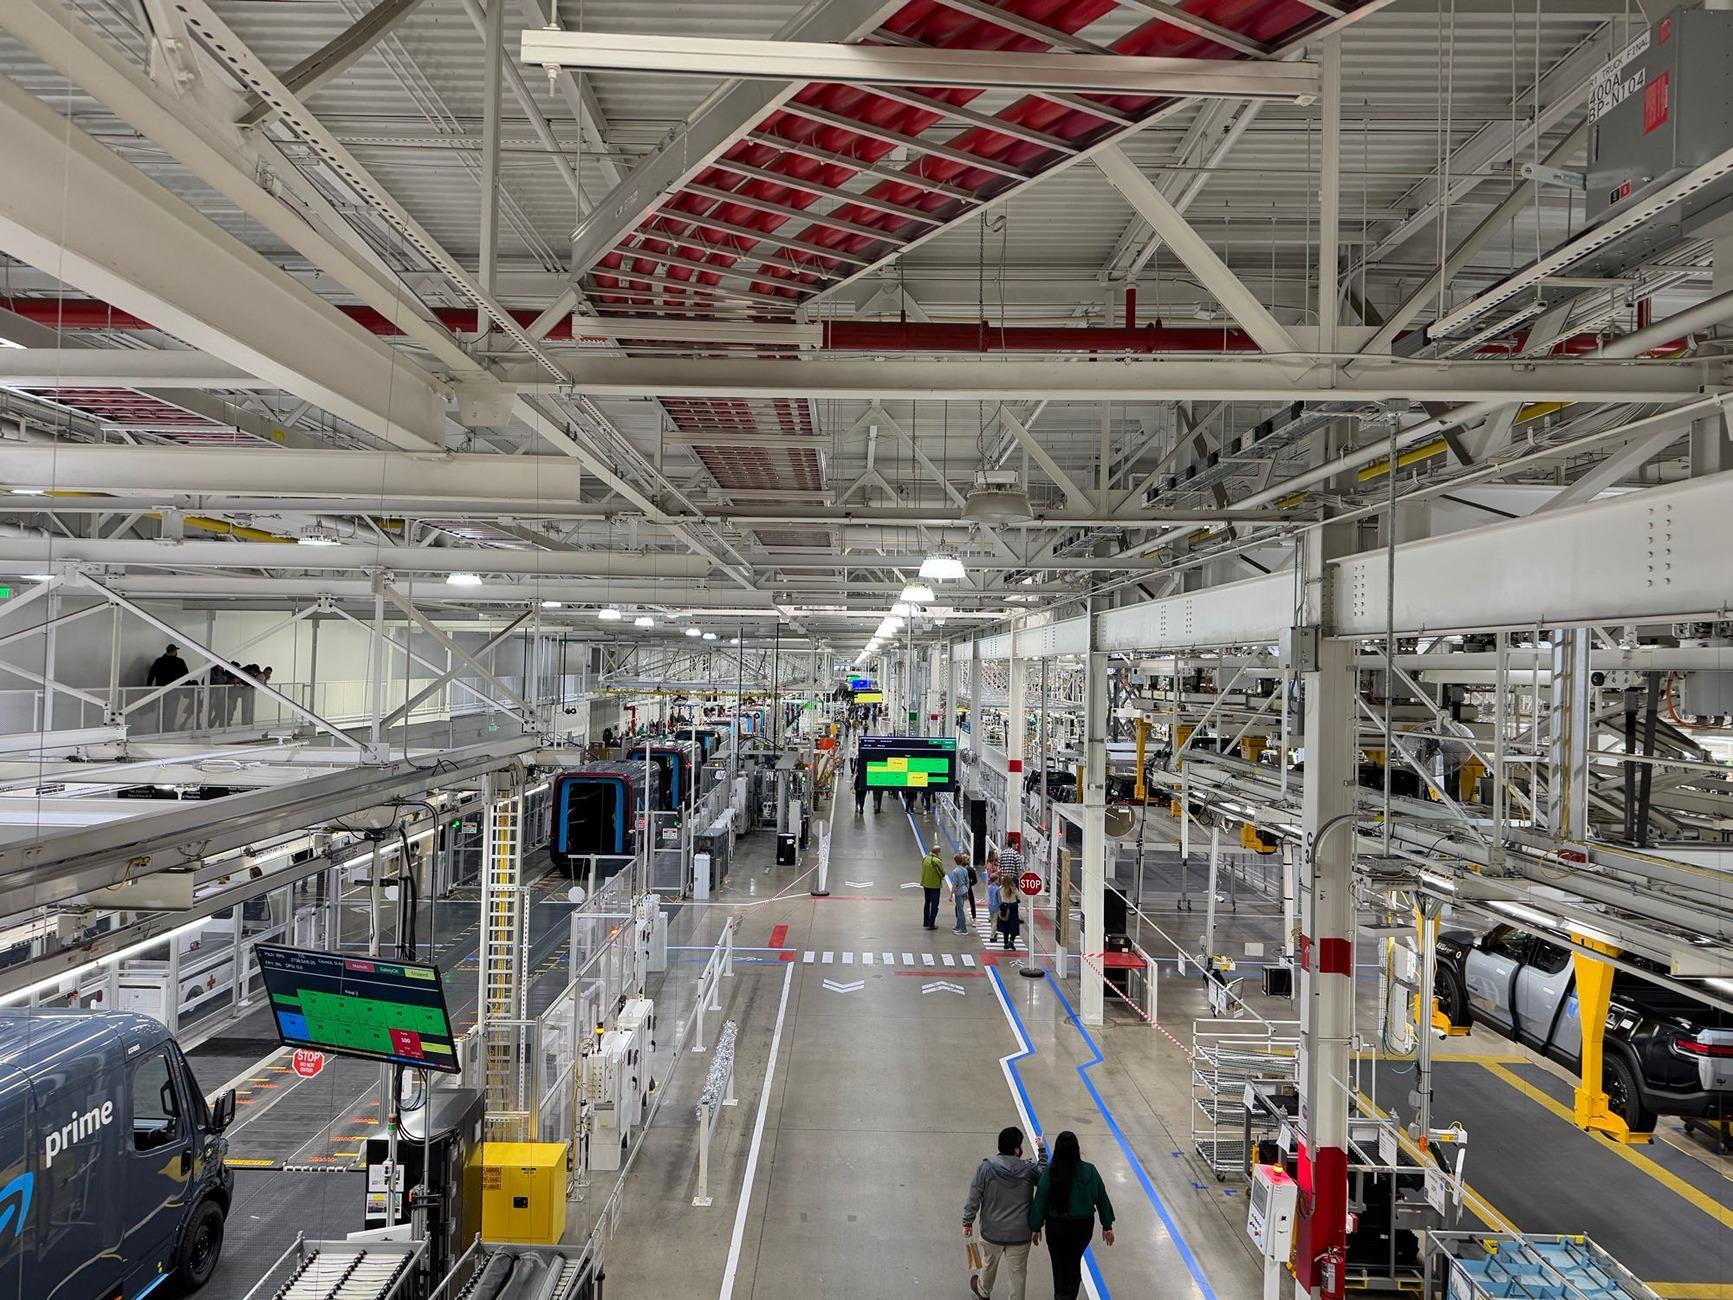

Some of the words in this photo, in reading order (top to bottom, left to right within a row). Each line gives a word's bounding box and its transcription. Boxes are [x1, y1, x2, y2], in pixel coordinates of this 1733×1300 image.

[1602, 57, 1623, 79] TRUCK
[1626, 38, 1648, 60] FINAL
[1588, 71, 1644, 124] BP-N104
[1590, 73, 1620, 105] 400A
[1307, 832, 1313, 847] C
[1020, 879, 1041, 889] STOP
[297, 1050, 320, 1062] STOP
[45, 1100, 113, 1168] prime
